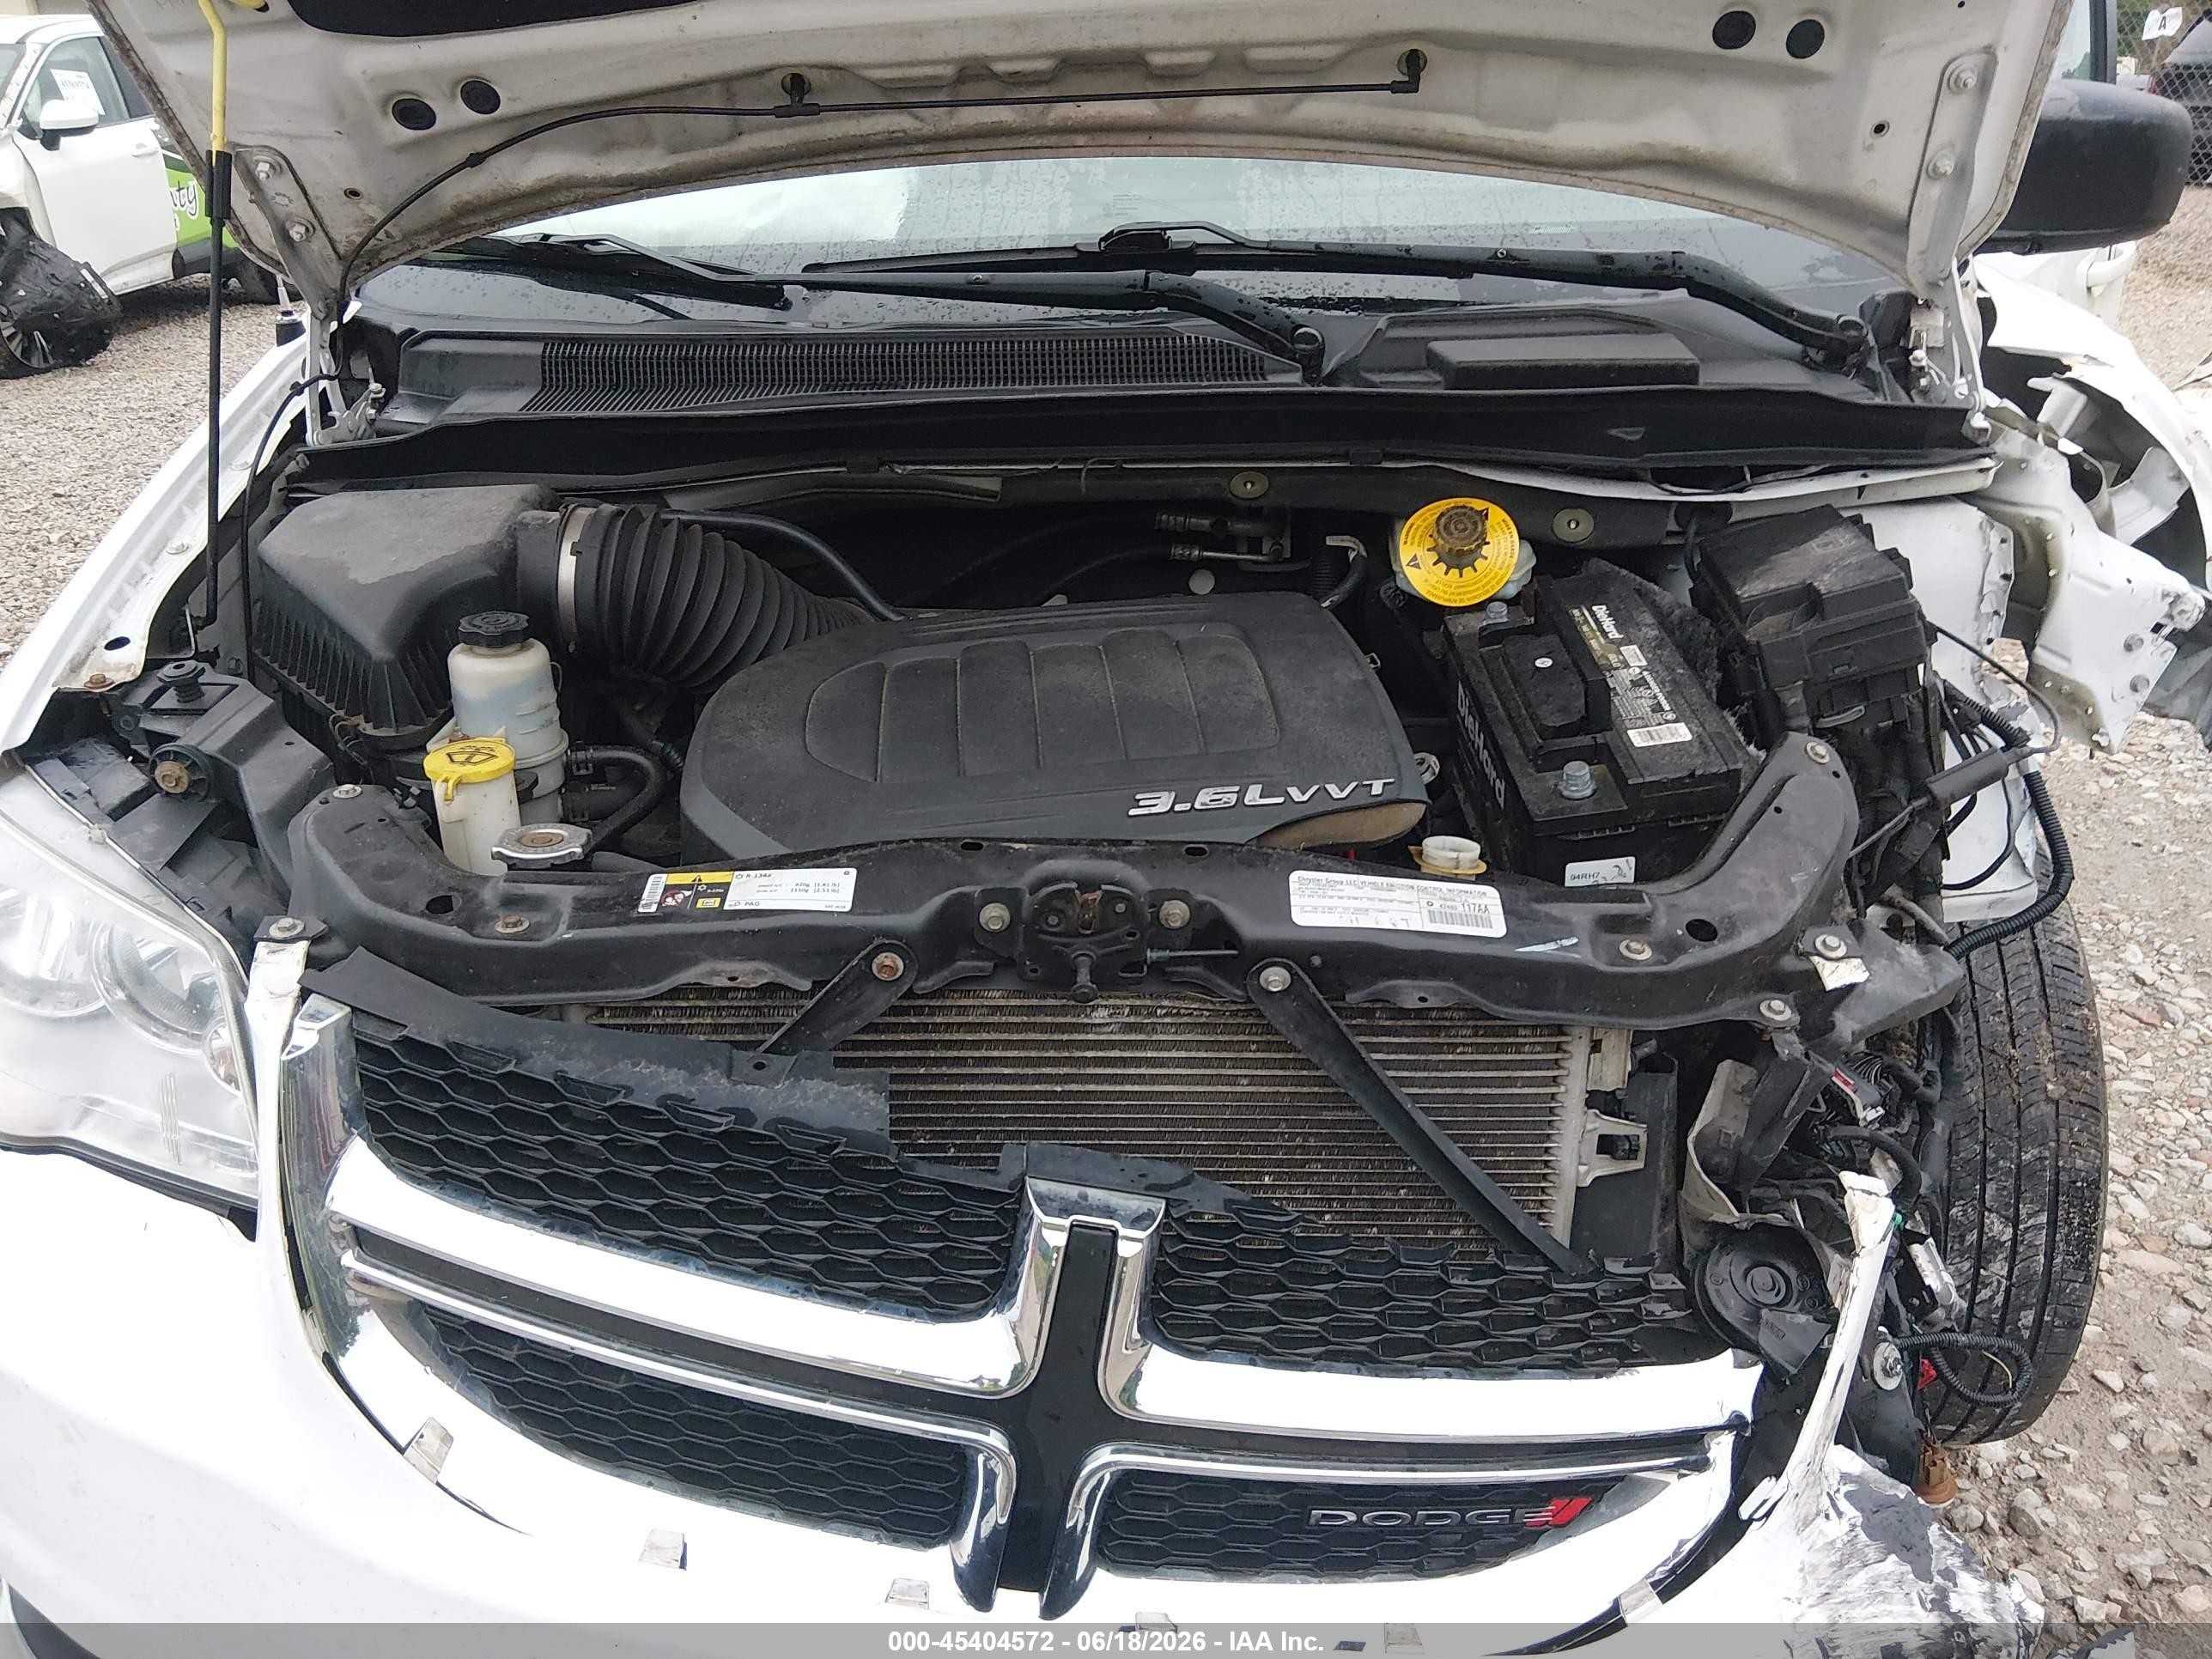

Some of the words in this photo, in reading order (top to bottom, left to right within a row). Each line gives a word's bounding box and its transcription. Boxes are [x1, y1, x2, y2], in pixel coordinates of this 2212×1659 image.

[2158, 15, 2166, 30] A
[1591, 605, 1625, 639] DieHard
[1457, 679, 1505, 810] DieHard
[1308, 1506, 1557, 1526] DODGE
